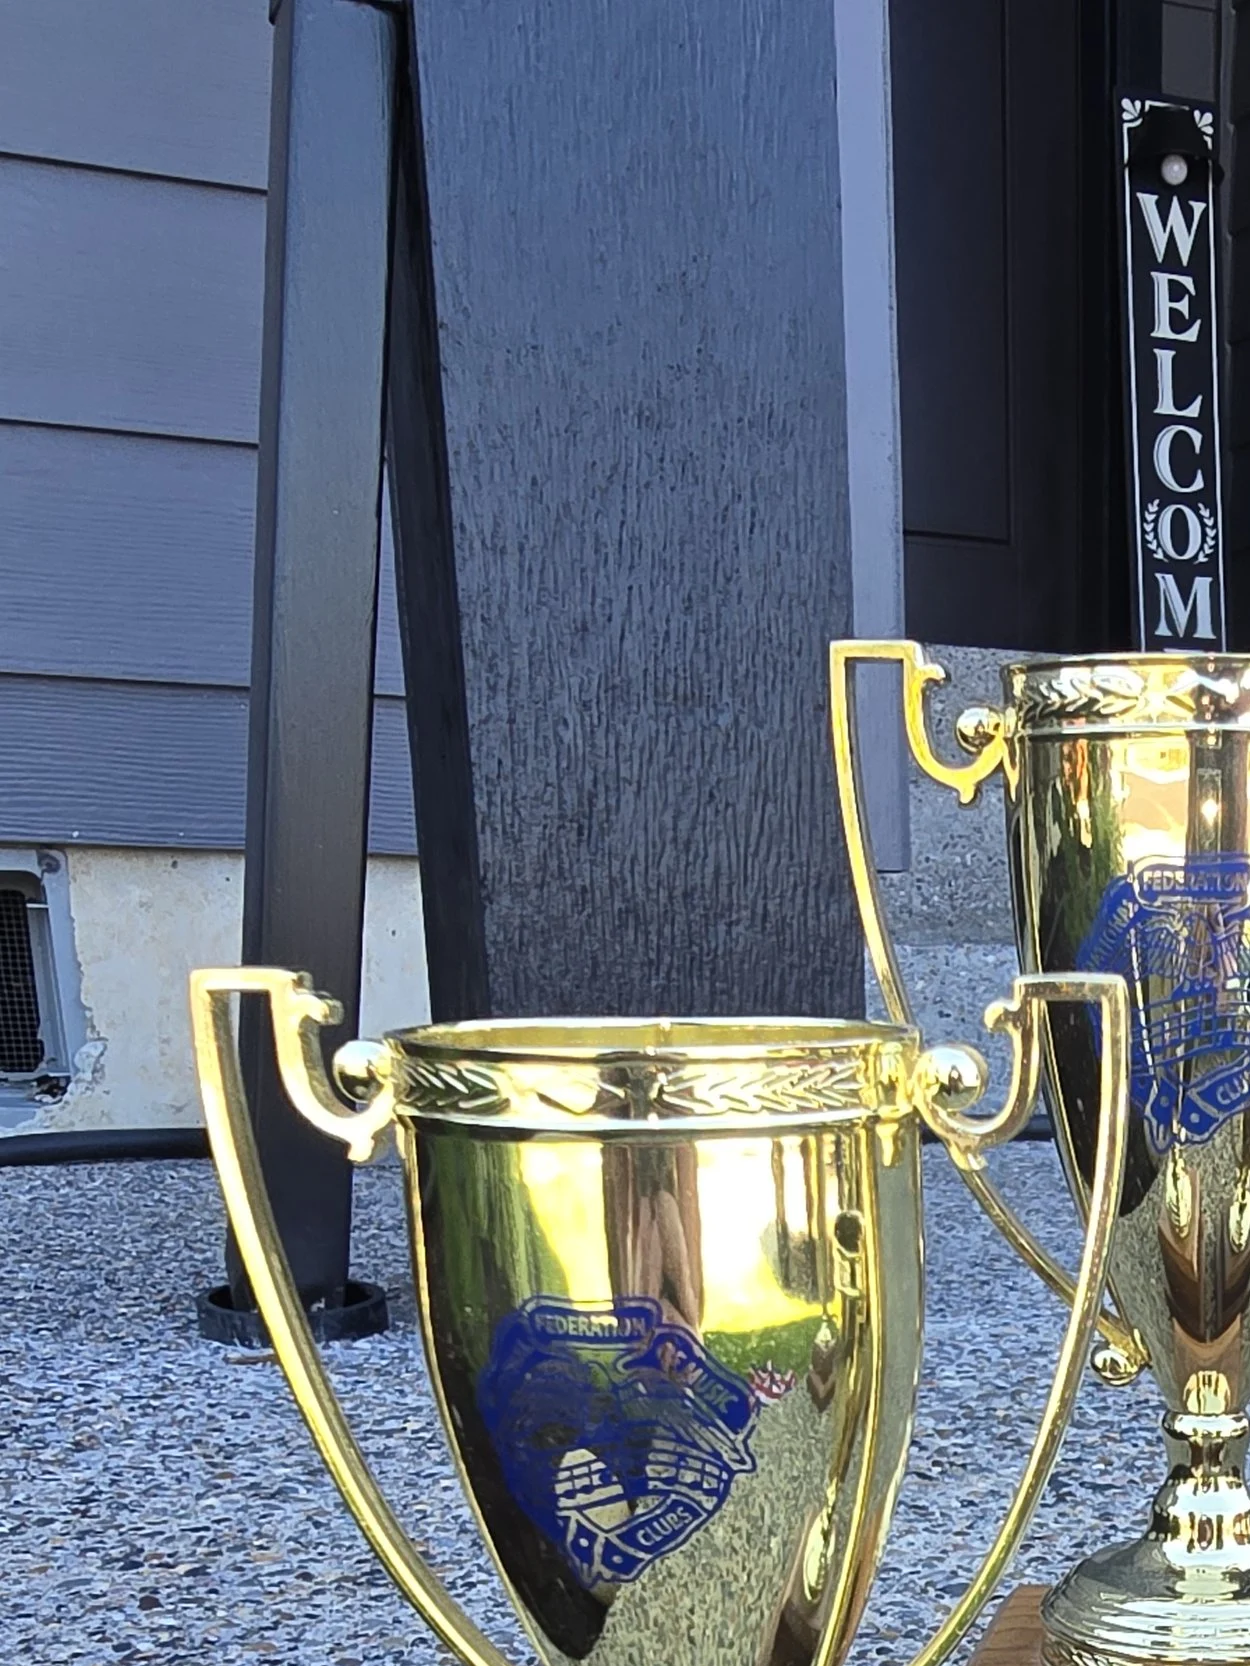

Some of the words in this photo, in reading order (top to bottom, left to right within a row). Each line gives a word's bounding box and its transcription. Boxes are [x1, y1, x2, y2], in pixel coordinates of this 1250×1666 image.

[1136, 191, 1217, 652] WELCOM
[1143, 869, 1249, 893] FEDERATION
[535, 1314, 646, 1337] FEDERATION
[636, 1506, 694, 1547] CLUBS
